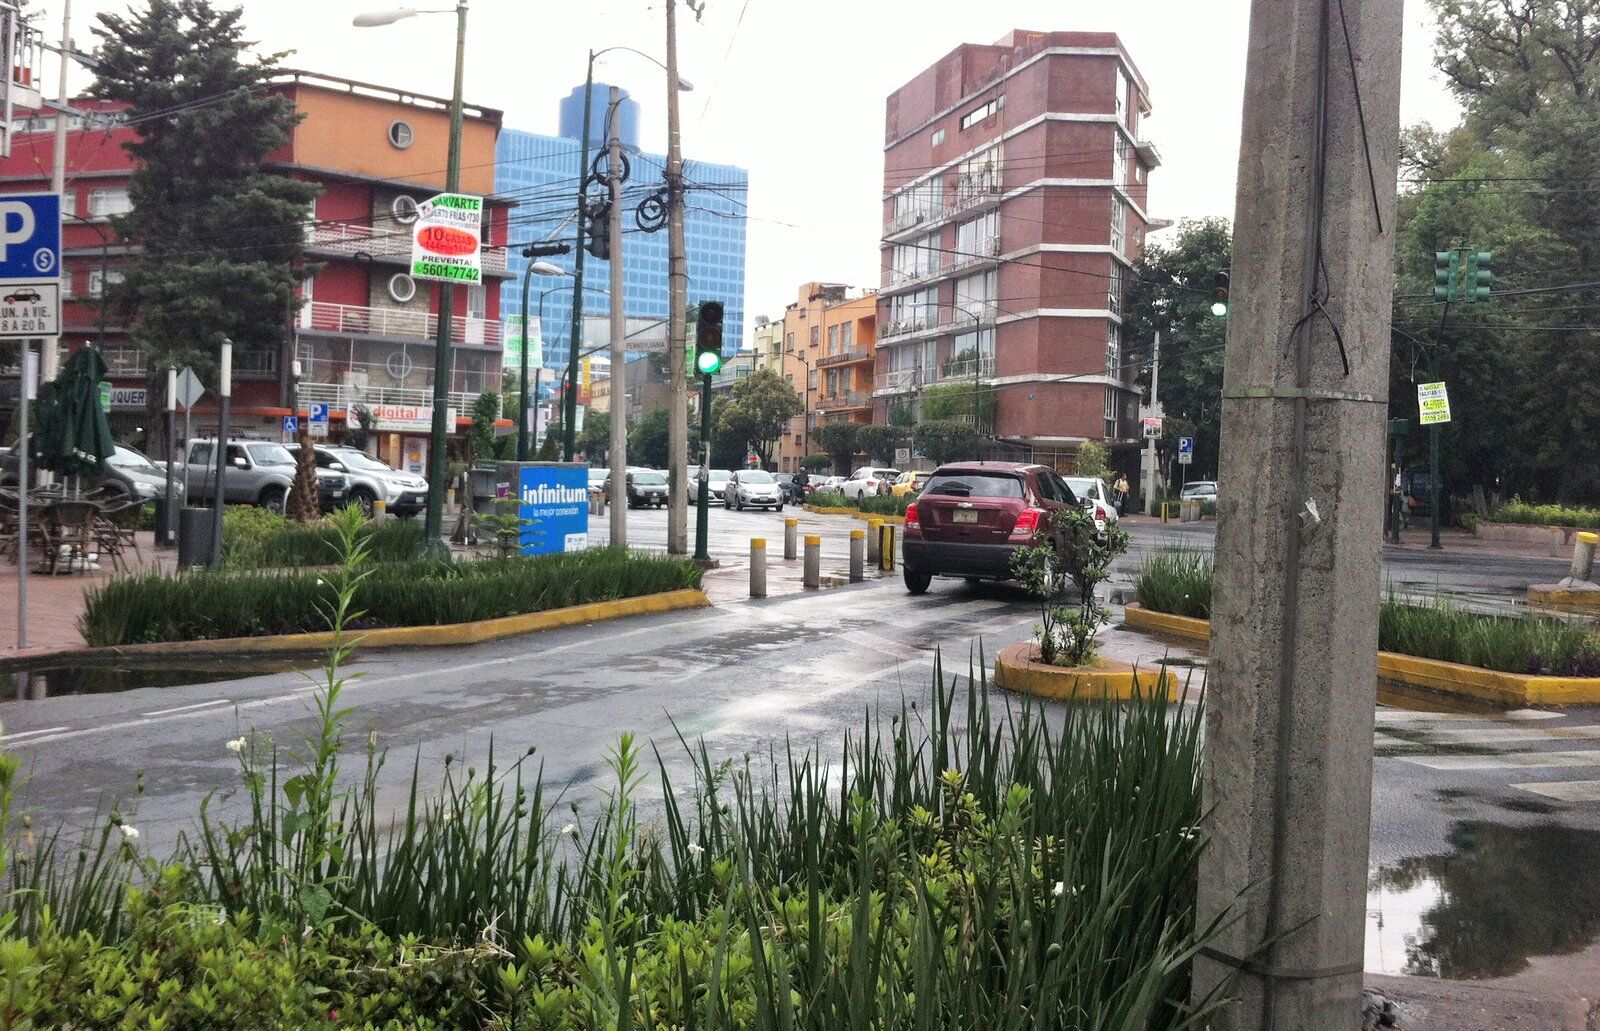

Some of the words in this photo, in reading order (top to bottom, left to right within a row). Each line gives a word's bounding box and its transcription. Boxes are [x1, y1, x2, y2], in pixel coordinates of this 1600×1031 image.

[425, 227, 444, 241] 10
[423, 265, 478, 280] 5601-7742
[0, 307, 19, 318] UN.
[22, 307, 29, 317] A
[33, 306, 50, 317] VIE.
[12, 320, 18, 331] A
[22, 320, 35, 331] 20
[373, 405, 418, 419] digital
[523, 483, 587, 505] infinitum
